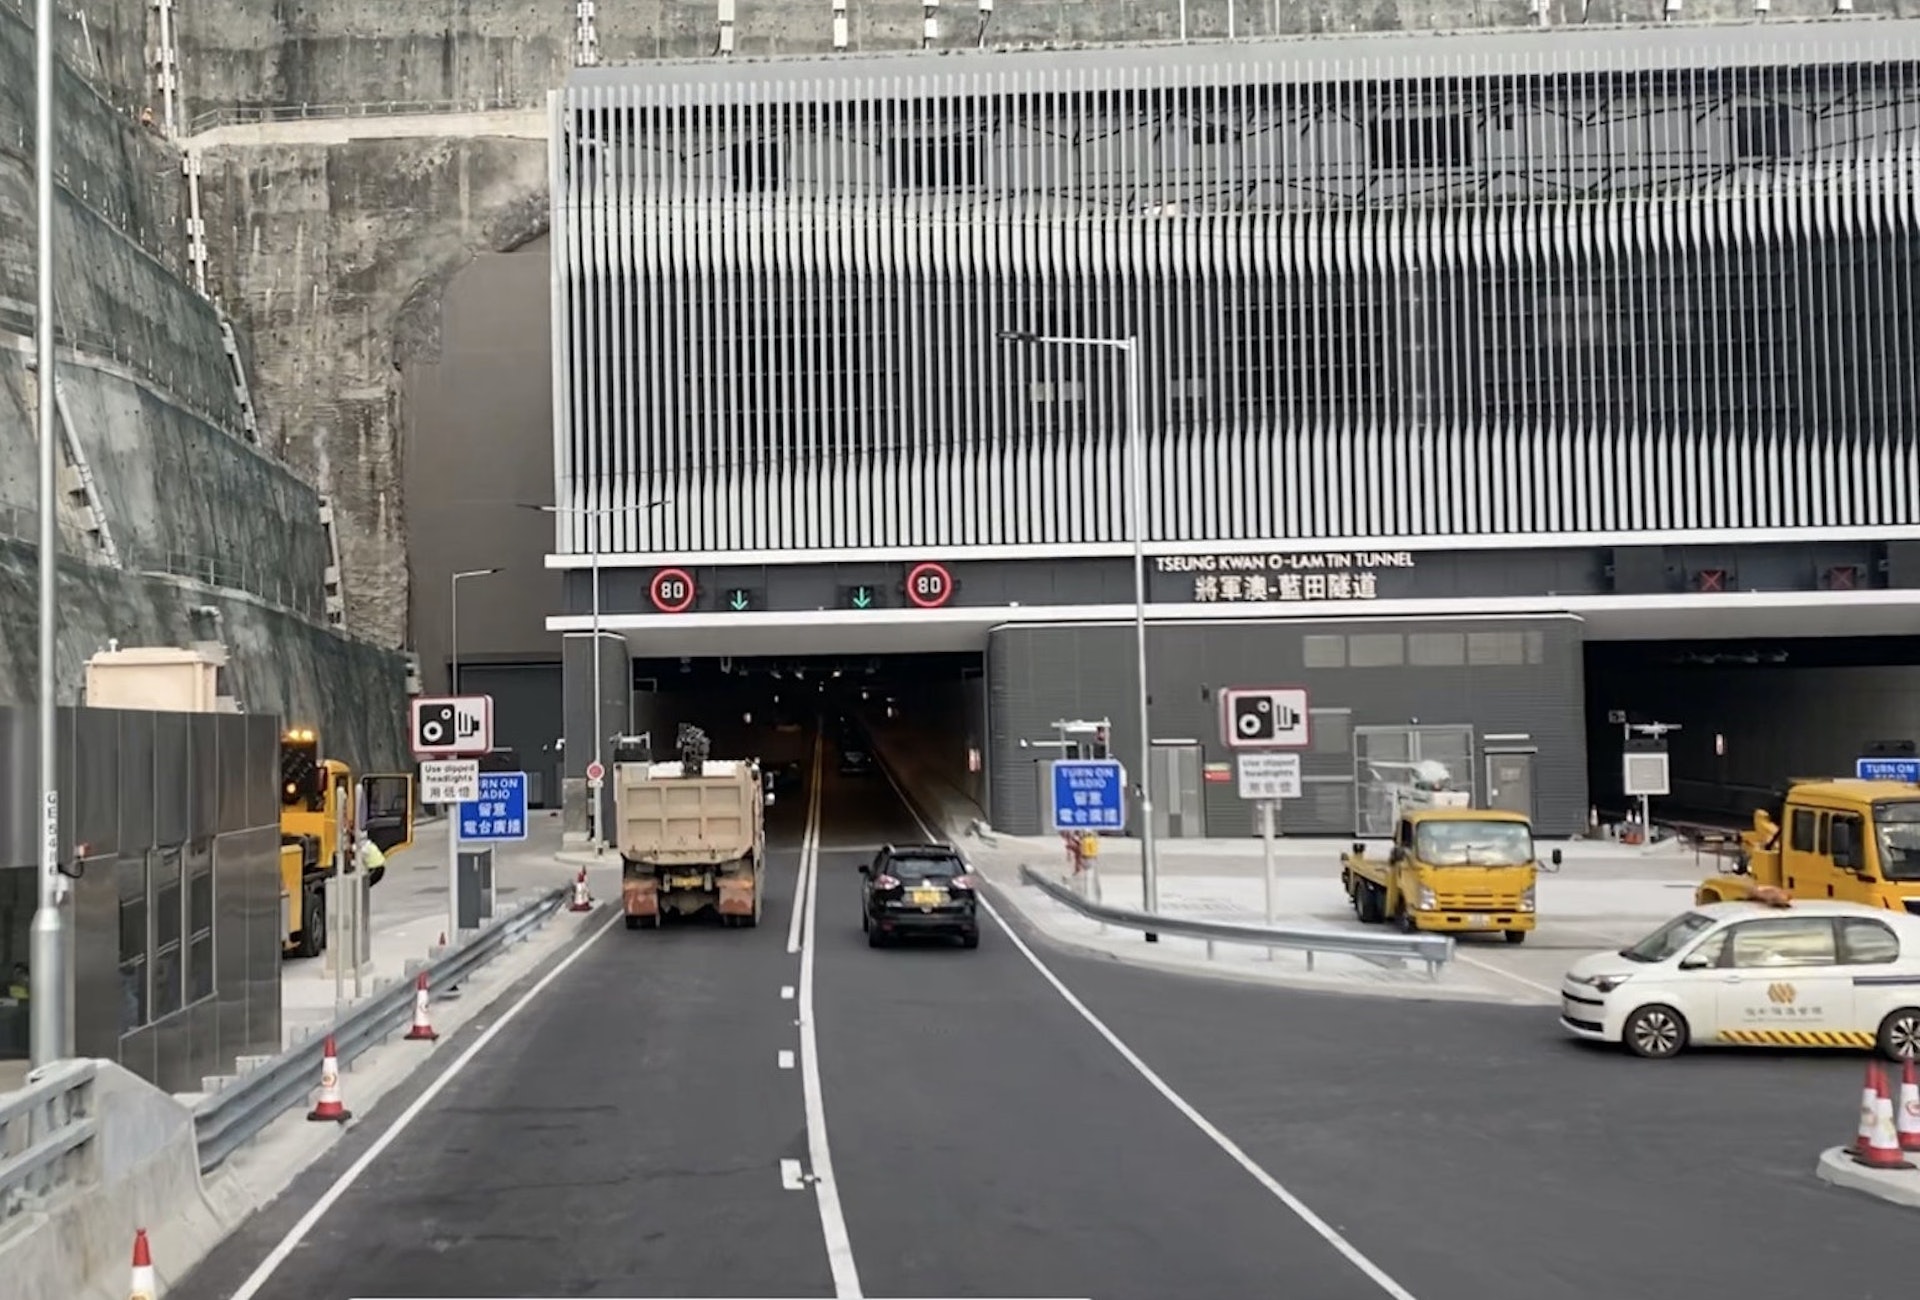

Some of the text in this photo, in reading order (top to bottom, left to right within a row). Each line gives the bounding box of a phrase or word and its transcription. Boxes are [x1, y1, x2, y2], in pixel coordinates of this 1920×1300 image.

[1156, 552, 1415, 572] TSEUNG KWAN O-LAM TIN TUNNEL
[661, 580, 685, 599] 80
[917, 576, 941, 595] 80
[1195, 573, 1377, 602] 將軍澳-藍田隧道
[425, 764, 475, 775] Use dipped
[1061, 767, 1114, 778] TURN ON
[1866, 764, 1915, 773] TURN ON
[426, 773, 473, 784] headlights
[500, 778, 518, 788] ON
[1069, 778, 1107, 788] RADIO
[478, 802, 506, 817] 留意
[463, 819, 522, 834] 電台廣播
